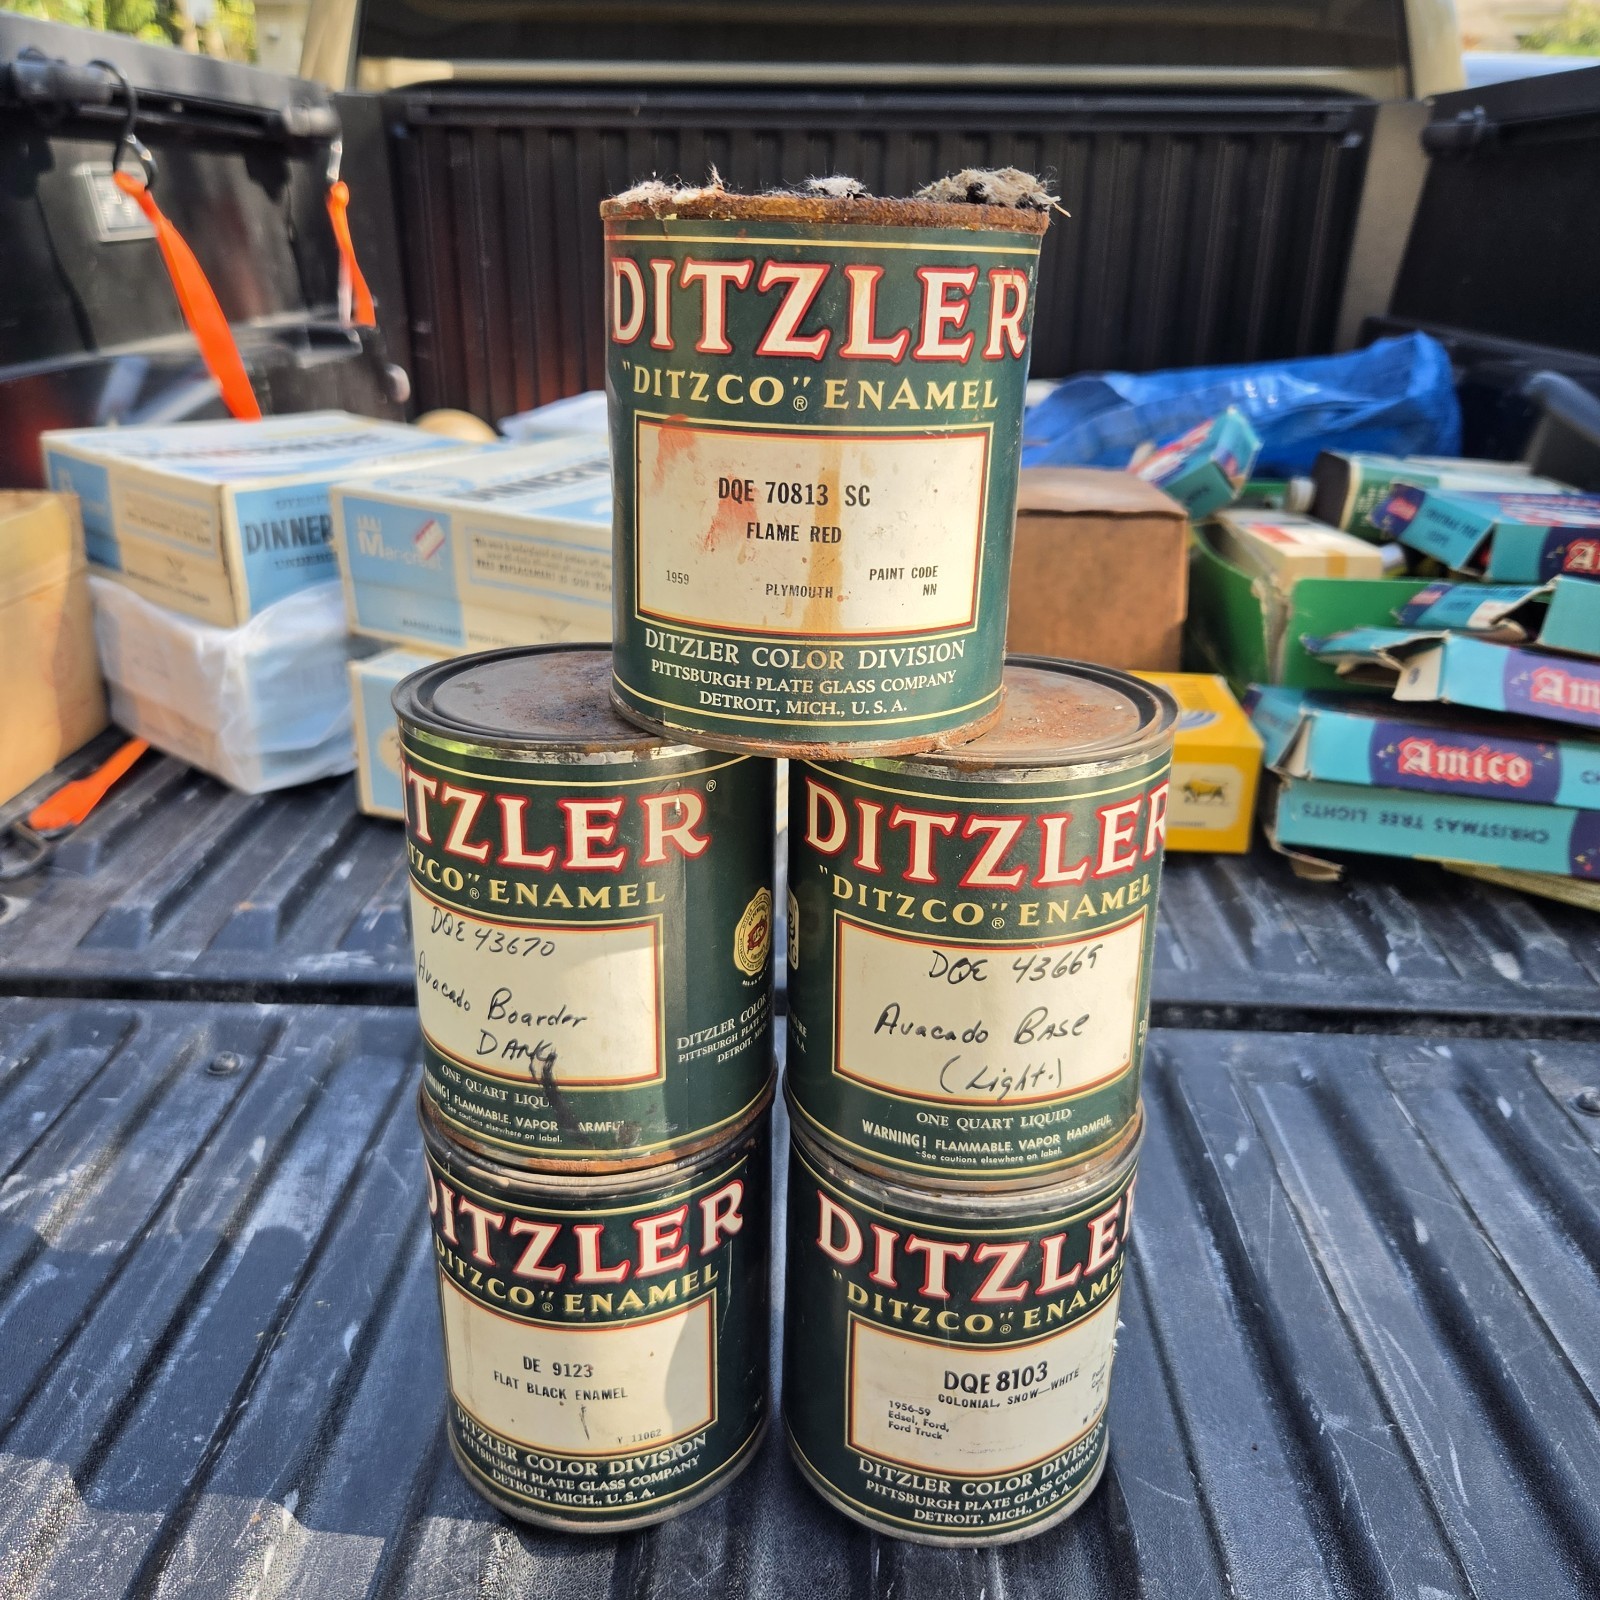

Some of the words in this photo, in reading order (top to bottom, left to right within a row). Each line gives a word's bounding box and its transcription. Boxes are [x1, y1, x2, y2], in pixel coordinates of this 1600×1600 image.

[611, 256, 1028, 364] DITZLER
[823, 379, 999, 411] ENAMEL
[718, 477, 755, 502] DQE
[765, 481, 829, 506] 70813
[845, 484, 871, 507] SC
[746, 522, 800, 542] FLAME
[810, 525, 842, 544] RED
[666, 570, 690, 586] 1959
[869, 567, 904, 581] PAINT
[911, 565, 939, 579] CODE
[765, 583, 834, 599] PLYMOUTH
[922, 583, 938, 596] NN
[645, 628, 740, 664] DITZLER
[752, 646, 845, 670] COLOR
[858, 639, 966, 670] DIVISION
[651, 659, 751, 689] PITTSBURGH
[756, 676, 813, 694] PLATE
[819, 679, 876, 695] GLASS
[881, 670, 957, 693] COMPANY
[700, 691, 780, 716] DETROIT,
[1400, 738, 1531, 787] Amico
[1301, 801, 1368, 823] LIGHTS
[1379, 810, 1424, 830] TREE
[804, 776, 1170, 890] DITZLER
[1433, 817, 1550, 844] CHRISTMAS
[489, 879, 666, 909] ENAMEL
[1018, 873, 1151, 927] ENAMEL
[431, 907, 465, 942] DQE
[475, 927, 556, 957] 43670
[1012, 943, 1104, 984] 43669
[677, 1018, 736, 1050] DITZLER
[678, 1033, 738, 1064] PITTSBURGH
[441, 1064, 461, 1084] ONE
[465, 1078, 509, 1101] QUART
[515, 1093, 553, 1109] LIQU
[486, 1121, 522, 1138] elsewhere
[524, 1132, 535, 1141] on
[515, 1115, 559, 1131] VAPOR
[862, 1118, 927, 1149] WARNING!
[1018, 1134, 1061, 1150] VAPOR
[1066, 1113, 1113, 1141] HARMFUL
[916, 1111, 949, 1128] ONE
[956, 1116, 1014, 1132] QUART
[1020, 1108, 1072, 1128] LIQUID
[940, 1154, 977, 1164] cautions
[980, 1154, 1024, 1164] elsewhere
[1026, 1152, 1038, 1161] on
[564, 1262, 721, 1315] ENAMEL
[523, 1356, 541, 1373] DE
[552, 1362, 594, 1378] 9123
[944, 1370, 991, 1394] DQE
[996, 1360, 1048, 1392] 8103
[494, 1370, 520, 1390] FLAT
[527, 1382, 567, 1400] BLACK
[575, 1387, 628, 1401] ENAMEL
[888, 1410, 919, 1426] Edsel,
[922, 1418, 950, 1433] Ford,
[888, 1421, 912, 1434] Ford
[915, 1427, 943, 1440] Truck
[457, 1406, 519, 1462] DITZLER
[526, 1453, 599, 1476] COLOR
[608, 1432, 708, 1475] DIVISION
[531, 1473, 575, 1490] PLATE
[579, 1479, 626, 1492] GLASS
[628, 1454, 701, 1487] COMPANY
[858, 1457, 952, 1495] DITZLER
[961, 1474, 1034, 1497] COLOR
[866, 1480, 960, 1511] PITTSBURGH
[965, 1497, 1011, 1511] PLATE
[1014, 1480, 1054, 1505] GLASS
[913, 1509, 985, 1528] DETROIT,
